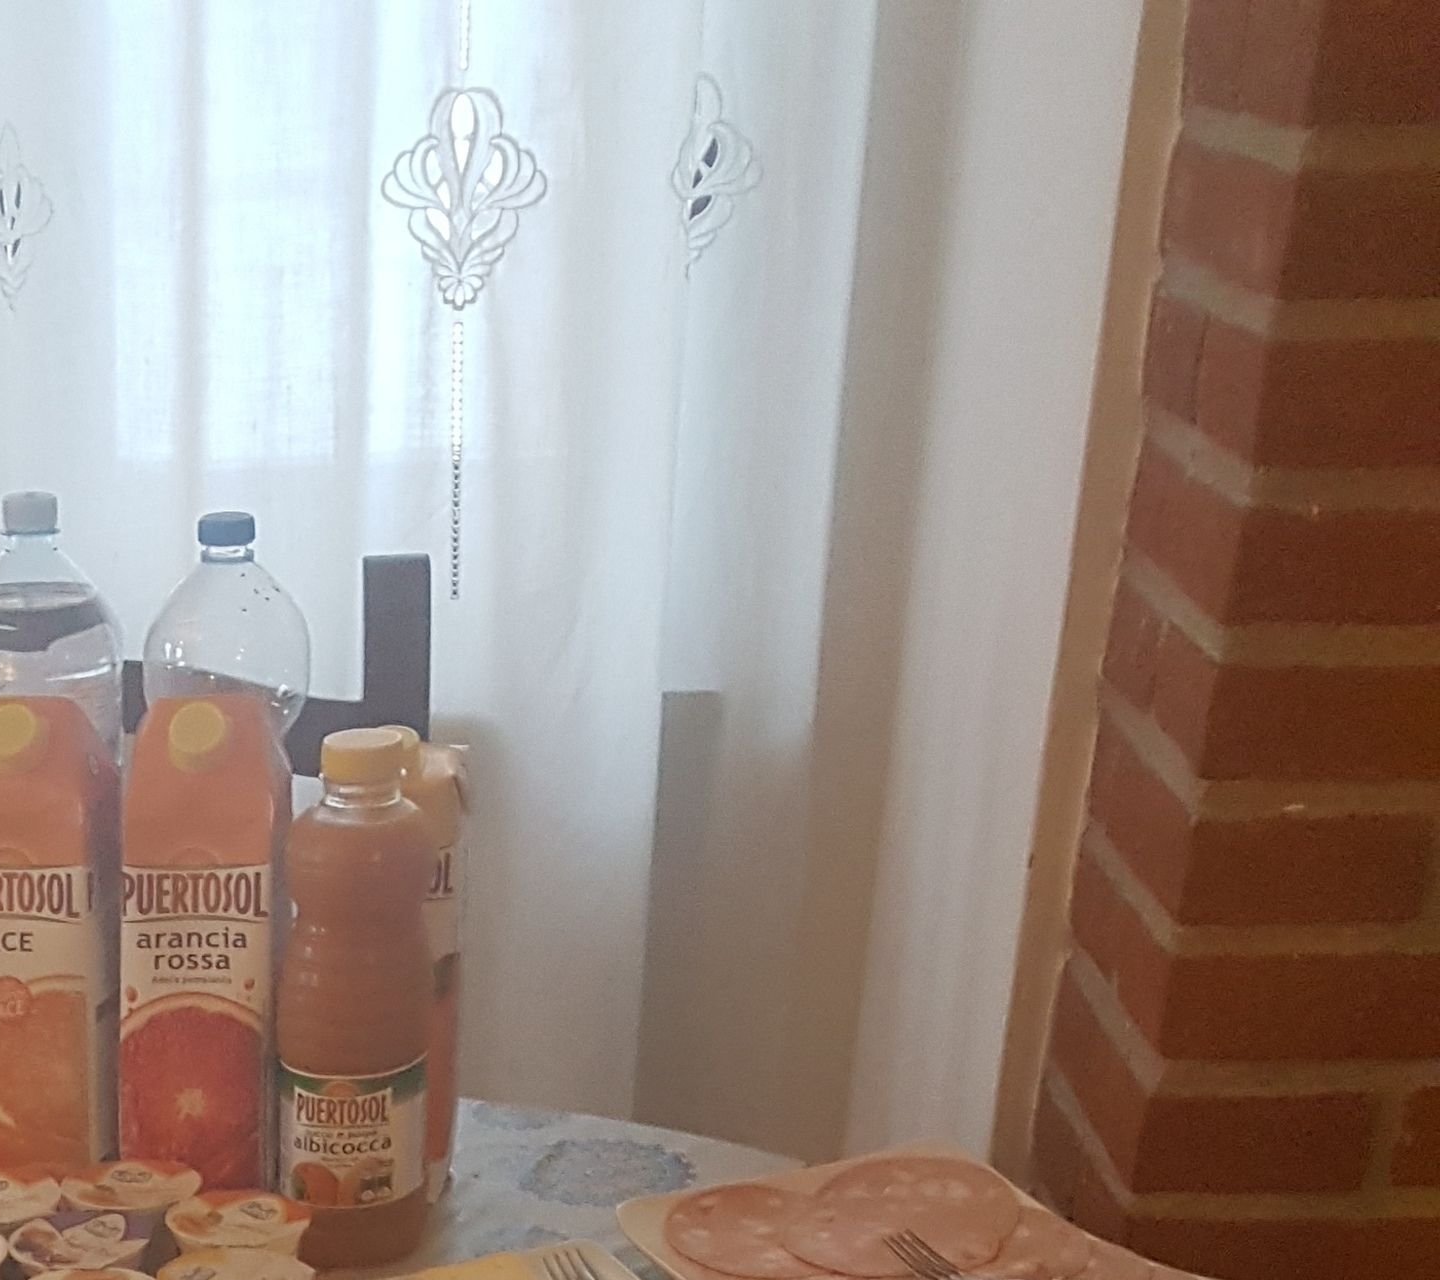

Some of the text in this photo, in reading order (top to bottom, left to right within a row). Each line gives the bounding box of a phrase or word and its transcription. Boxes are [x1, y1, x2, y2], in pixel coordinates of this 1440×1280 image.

[121, 870, 269, 918] PUERTOSOL
[135, 926, 248, 949] arancia
[154, 953, 231, 970] rossa
[295, 1092, 390, 1125] PUERTOSOL
[293, 1135, 393, 1155] albicocca
